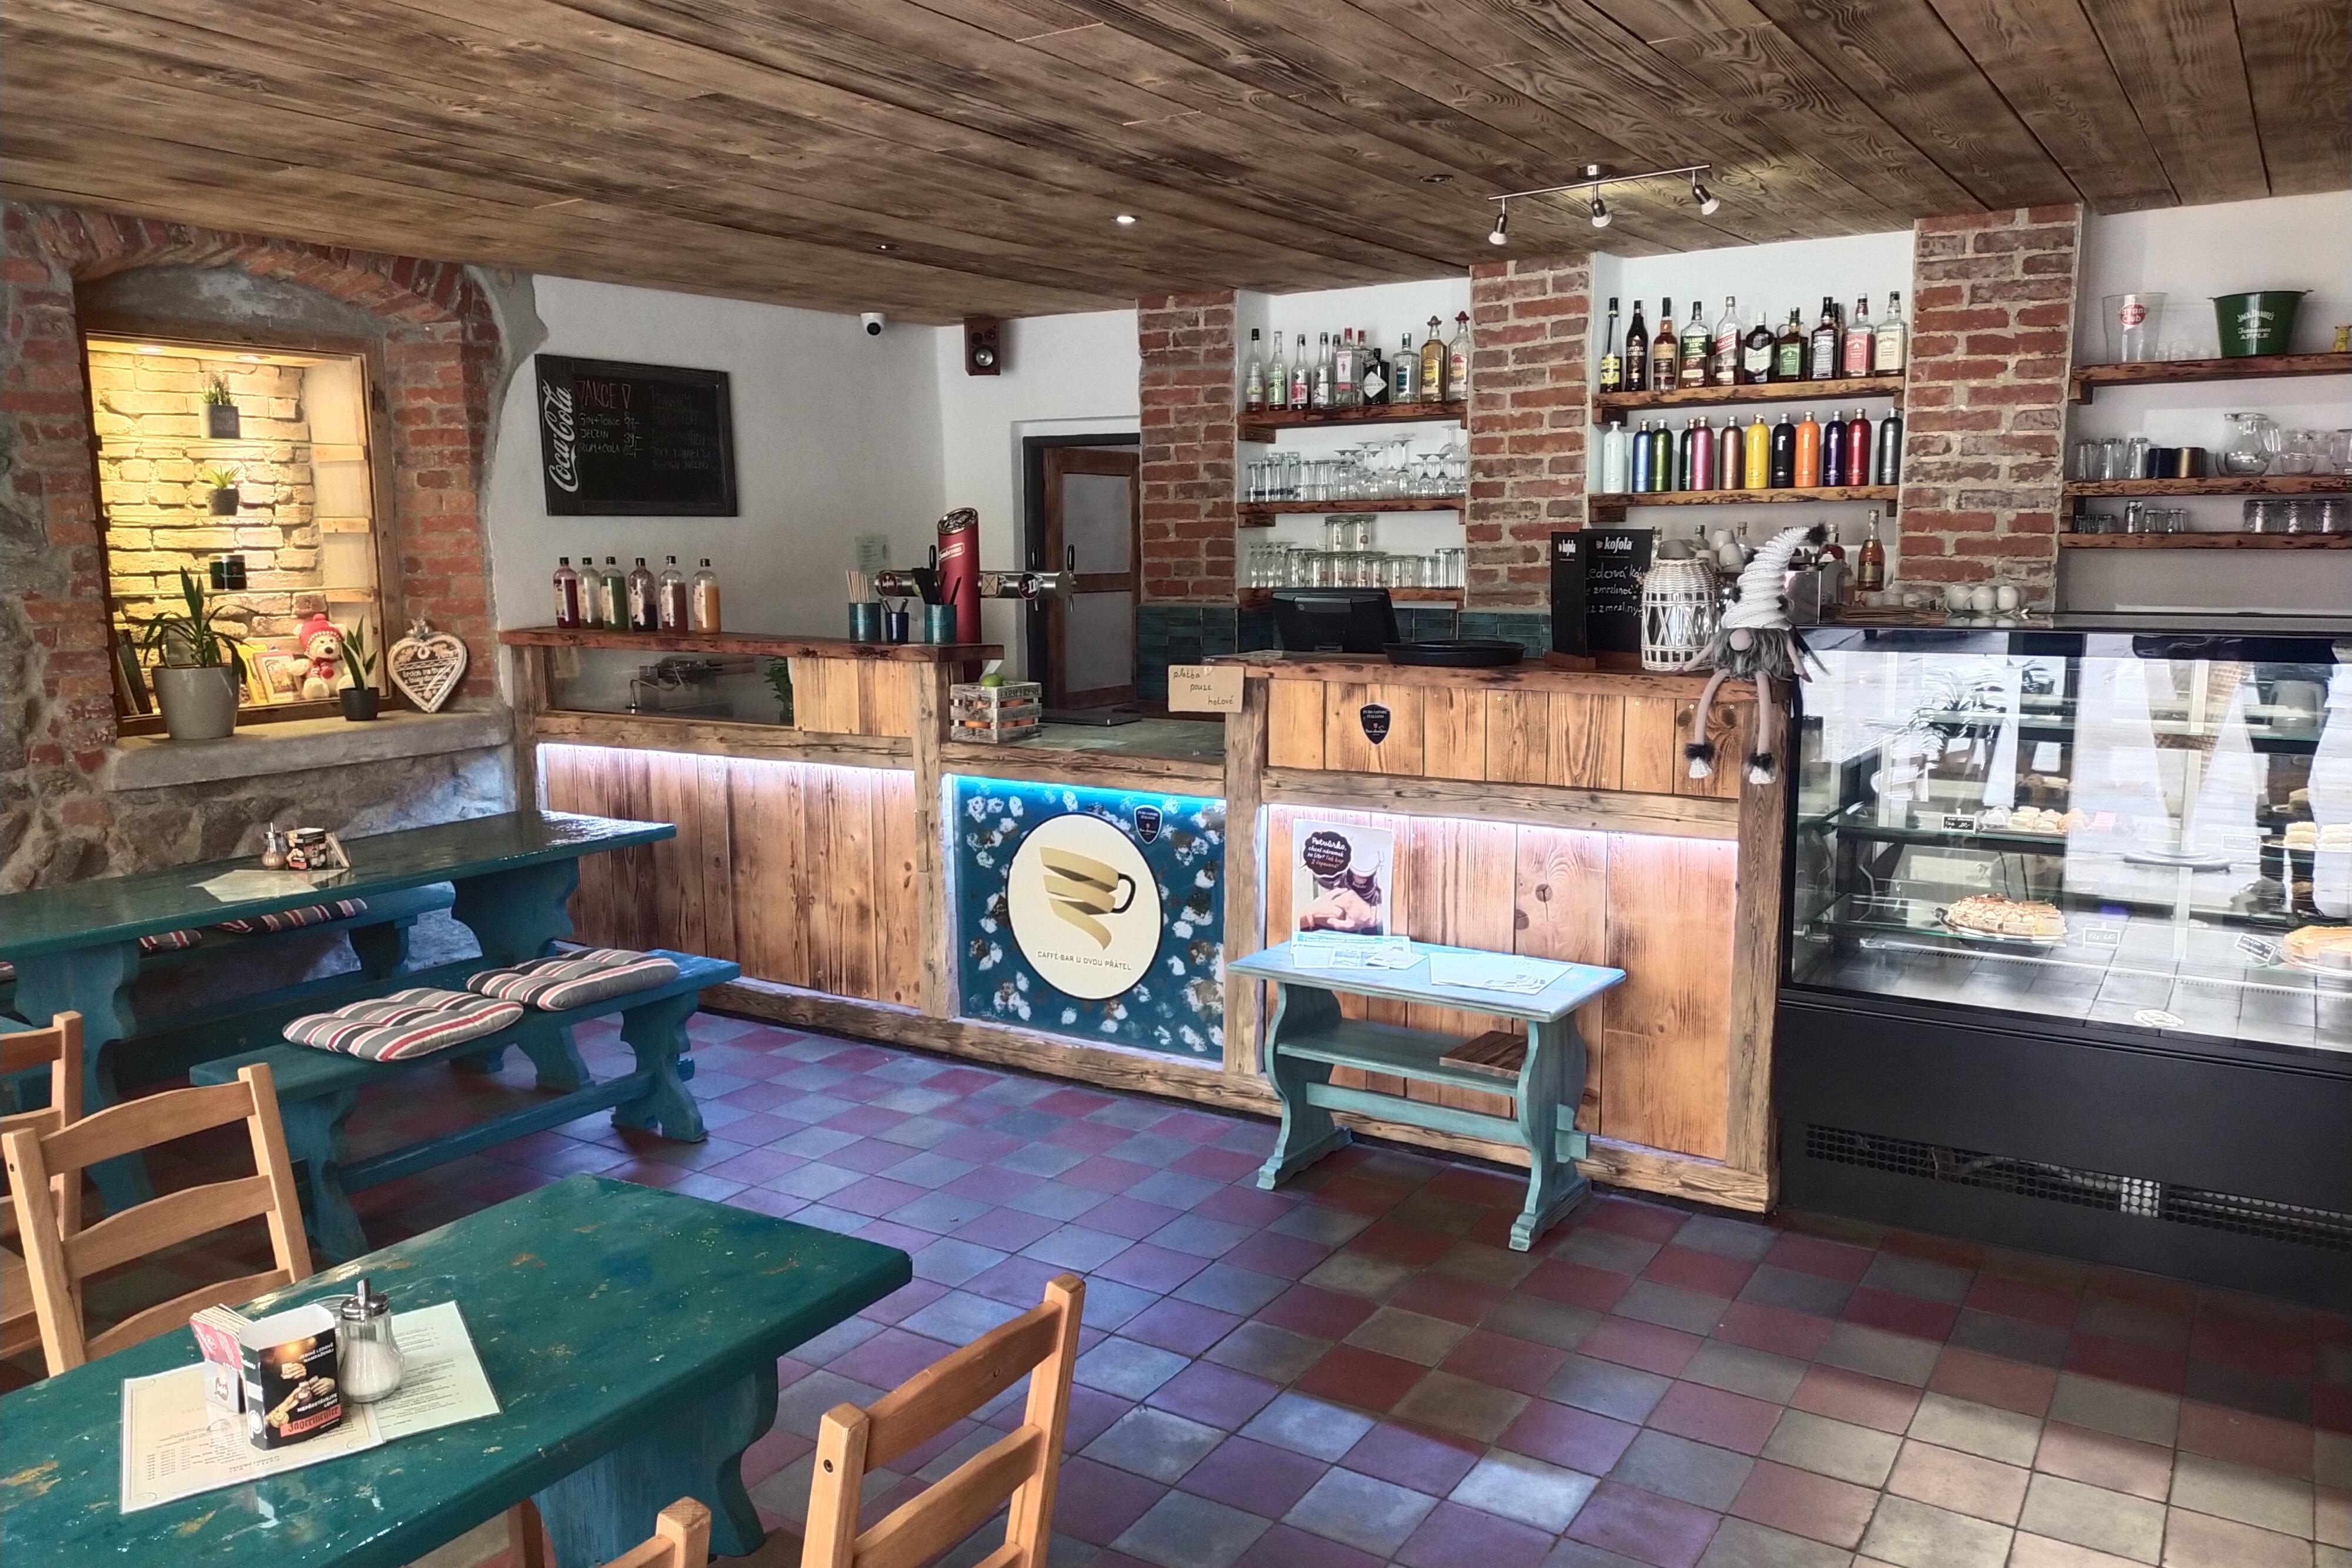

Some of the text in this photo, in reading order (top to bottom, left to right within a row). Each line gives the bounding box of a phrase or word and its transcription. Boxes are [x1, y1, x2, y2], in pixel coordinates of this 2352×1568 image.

[542, 379, 579, 492] Coca-Cola
[1562, 539, 1576, 556] kofola
[1604, 536, 1632, 553] kofola
[1586, 561, 1627, 580] edová
[1173, 668, 1201, 680] platba
[1190, 684, 1212, 693] pouze
[1084, 958, 1102, 966] DVOU
[1105, 959, 1131, 971] PŘÁTEL
[324, 1398, 338, 1408] LOVIT
